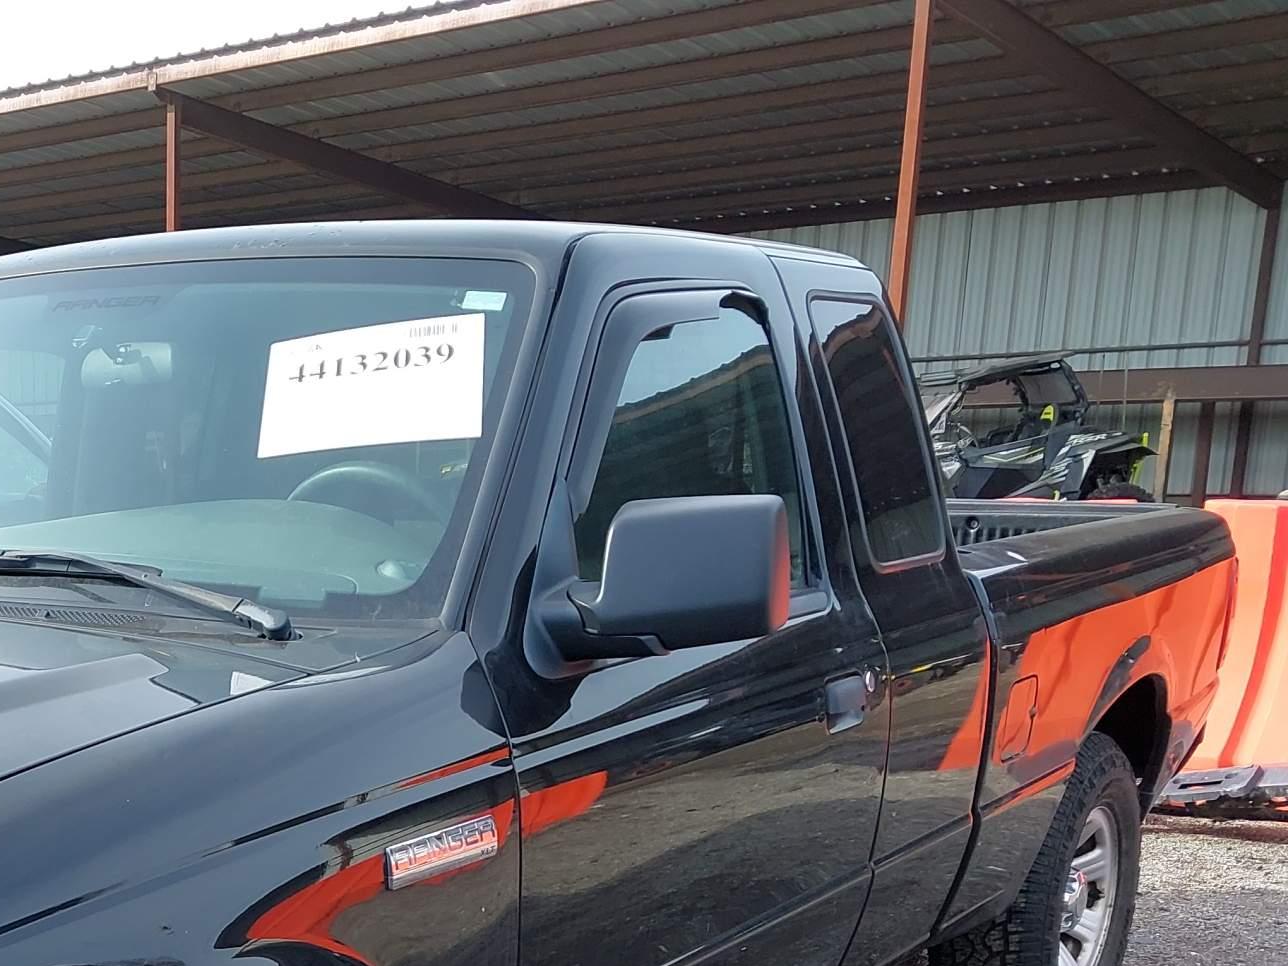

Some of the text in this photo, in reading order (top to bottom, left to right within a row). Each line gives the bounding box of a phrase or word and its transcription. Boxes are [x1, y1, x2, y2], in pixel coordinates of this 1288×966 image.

[52, 295, 160, 312] RANGER
[288, 343, 455, 383] 44132039
[391, 820, 495, 870] RANGER
[480, 845, 496, 856] XLT
